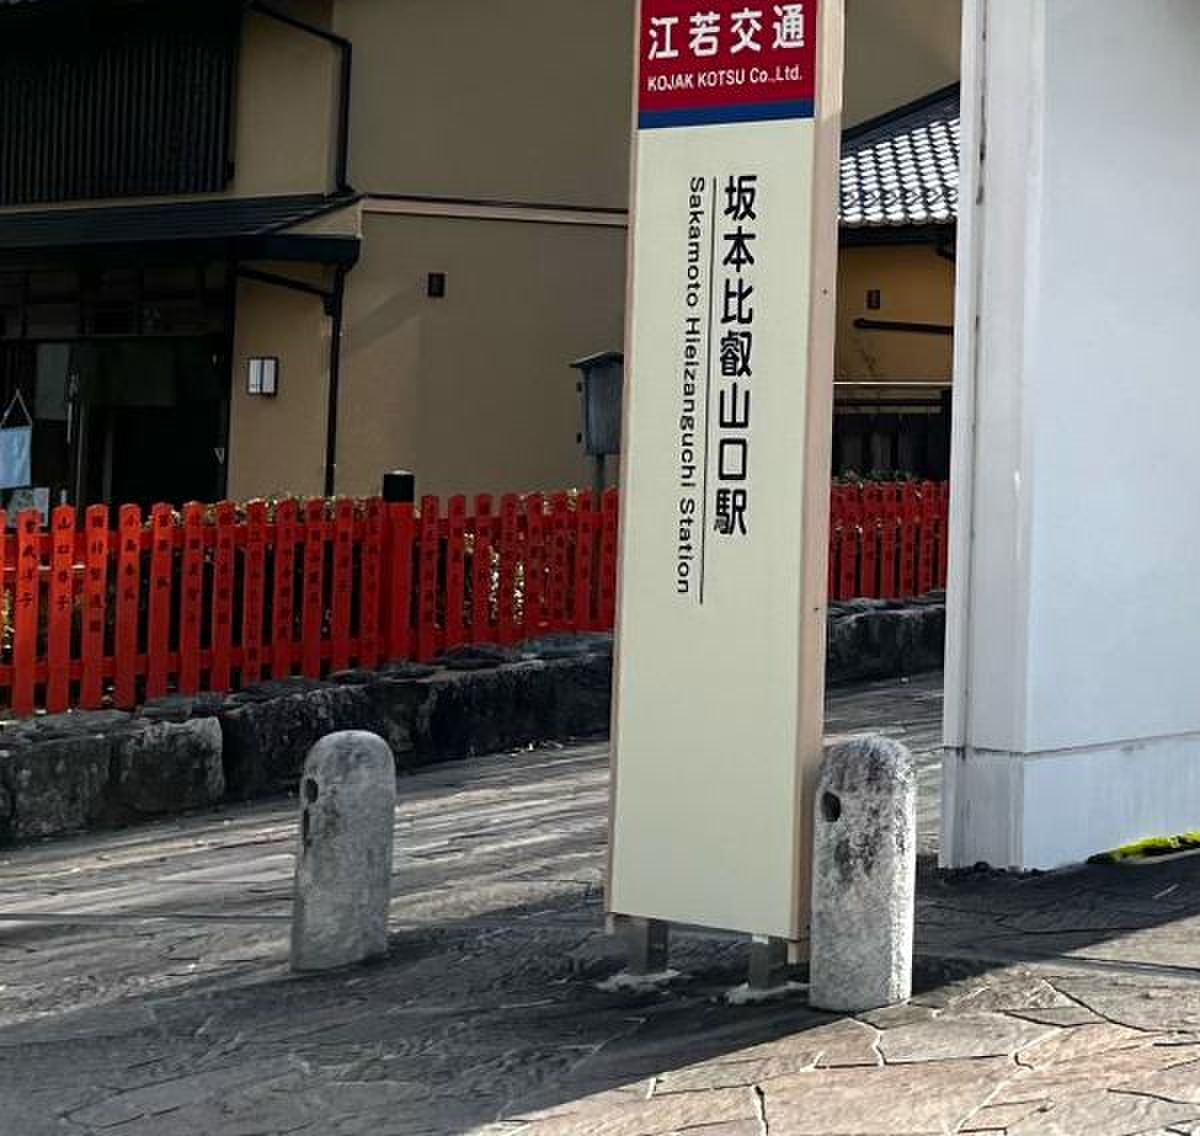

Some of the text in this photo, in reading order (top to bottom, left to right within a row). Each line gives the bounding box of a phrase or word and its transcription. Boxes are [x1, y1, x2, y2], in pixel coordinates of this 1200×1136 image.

[647, 3, 805, 61] 江若交通
[647, 73, 695, 92] KOJAK
[697, 69, 746, 88] KOTSU
[676, 176, 705, 594] Sakamoto Hieizanguchi Station
[714, 174, 758, 536] 坂本比叡山口駅
